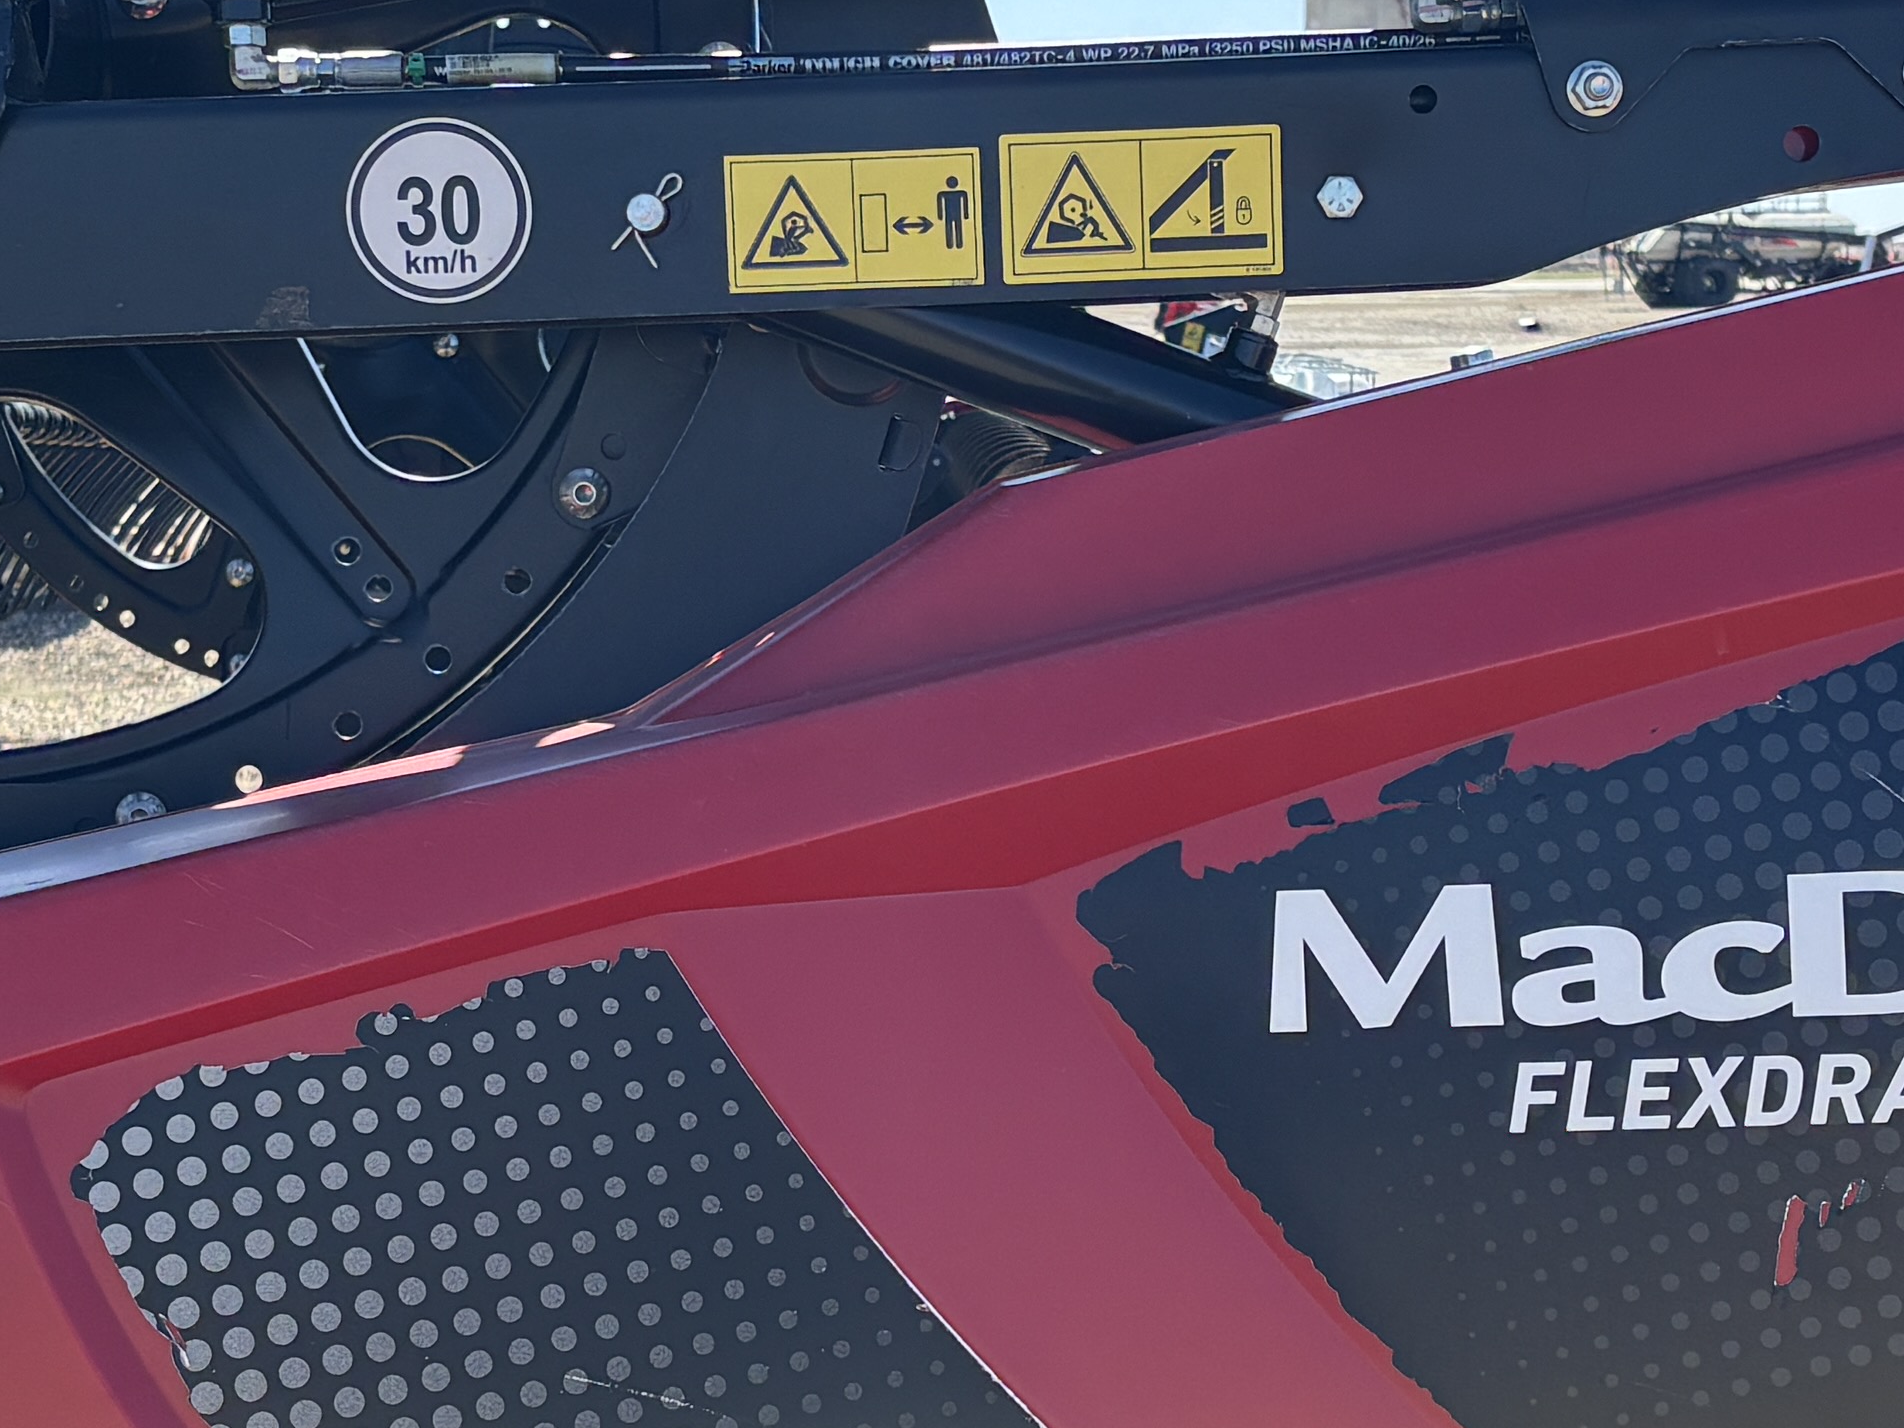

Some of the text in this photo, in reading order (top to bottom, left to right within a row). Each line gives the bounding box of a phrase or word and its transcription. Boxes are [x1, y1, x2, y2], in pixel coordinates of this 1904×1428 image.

[888, 53, 955, 69] COVER
[963, 50, 1076, 68] 481/482TC-4
[1082, 47, 1113, 62] WP
[1118, 45, 1155, 60] 22.7
[1161, 42, 1199, 58] MPa
[1205, 40, 1253, 56] (3250
[1300, 36, 1354, 52] MSHA
[1360, 33, 1436, 50] IC-40/26
[397, 175, 481, 247] 30
[405, 249, 477, 274] km/h
